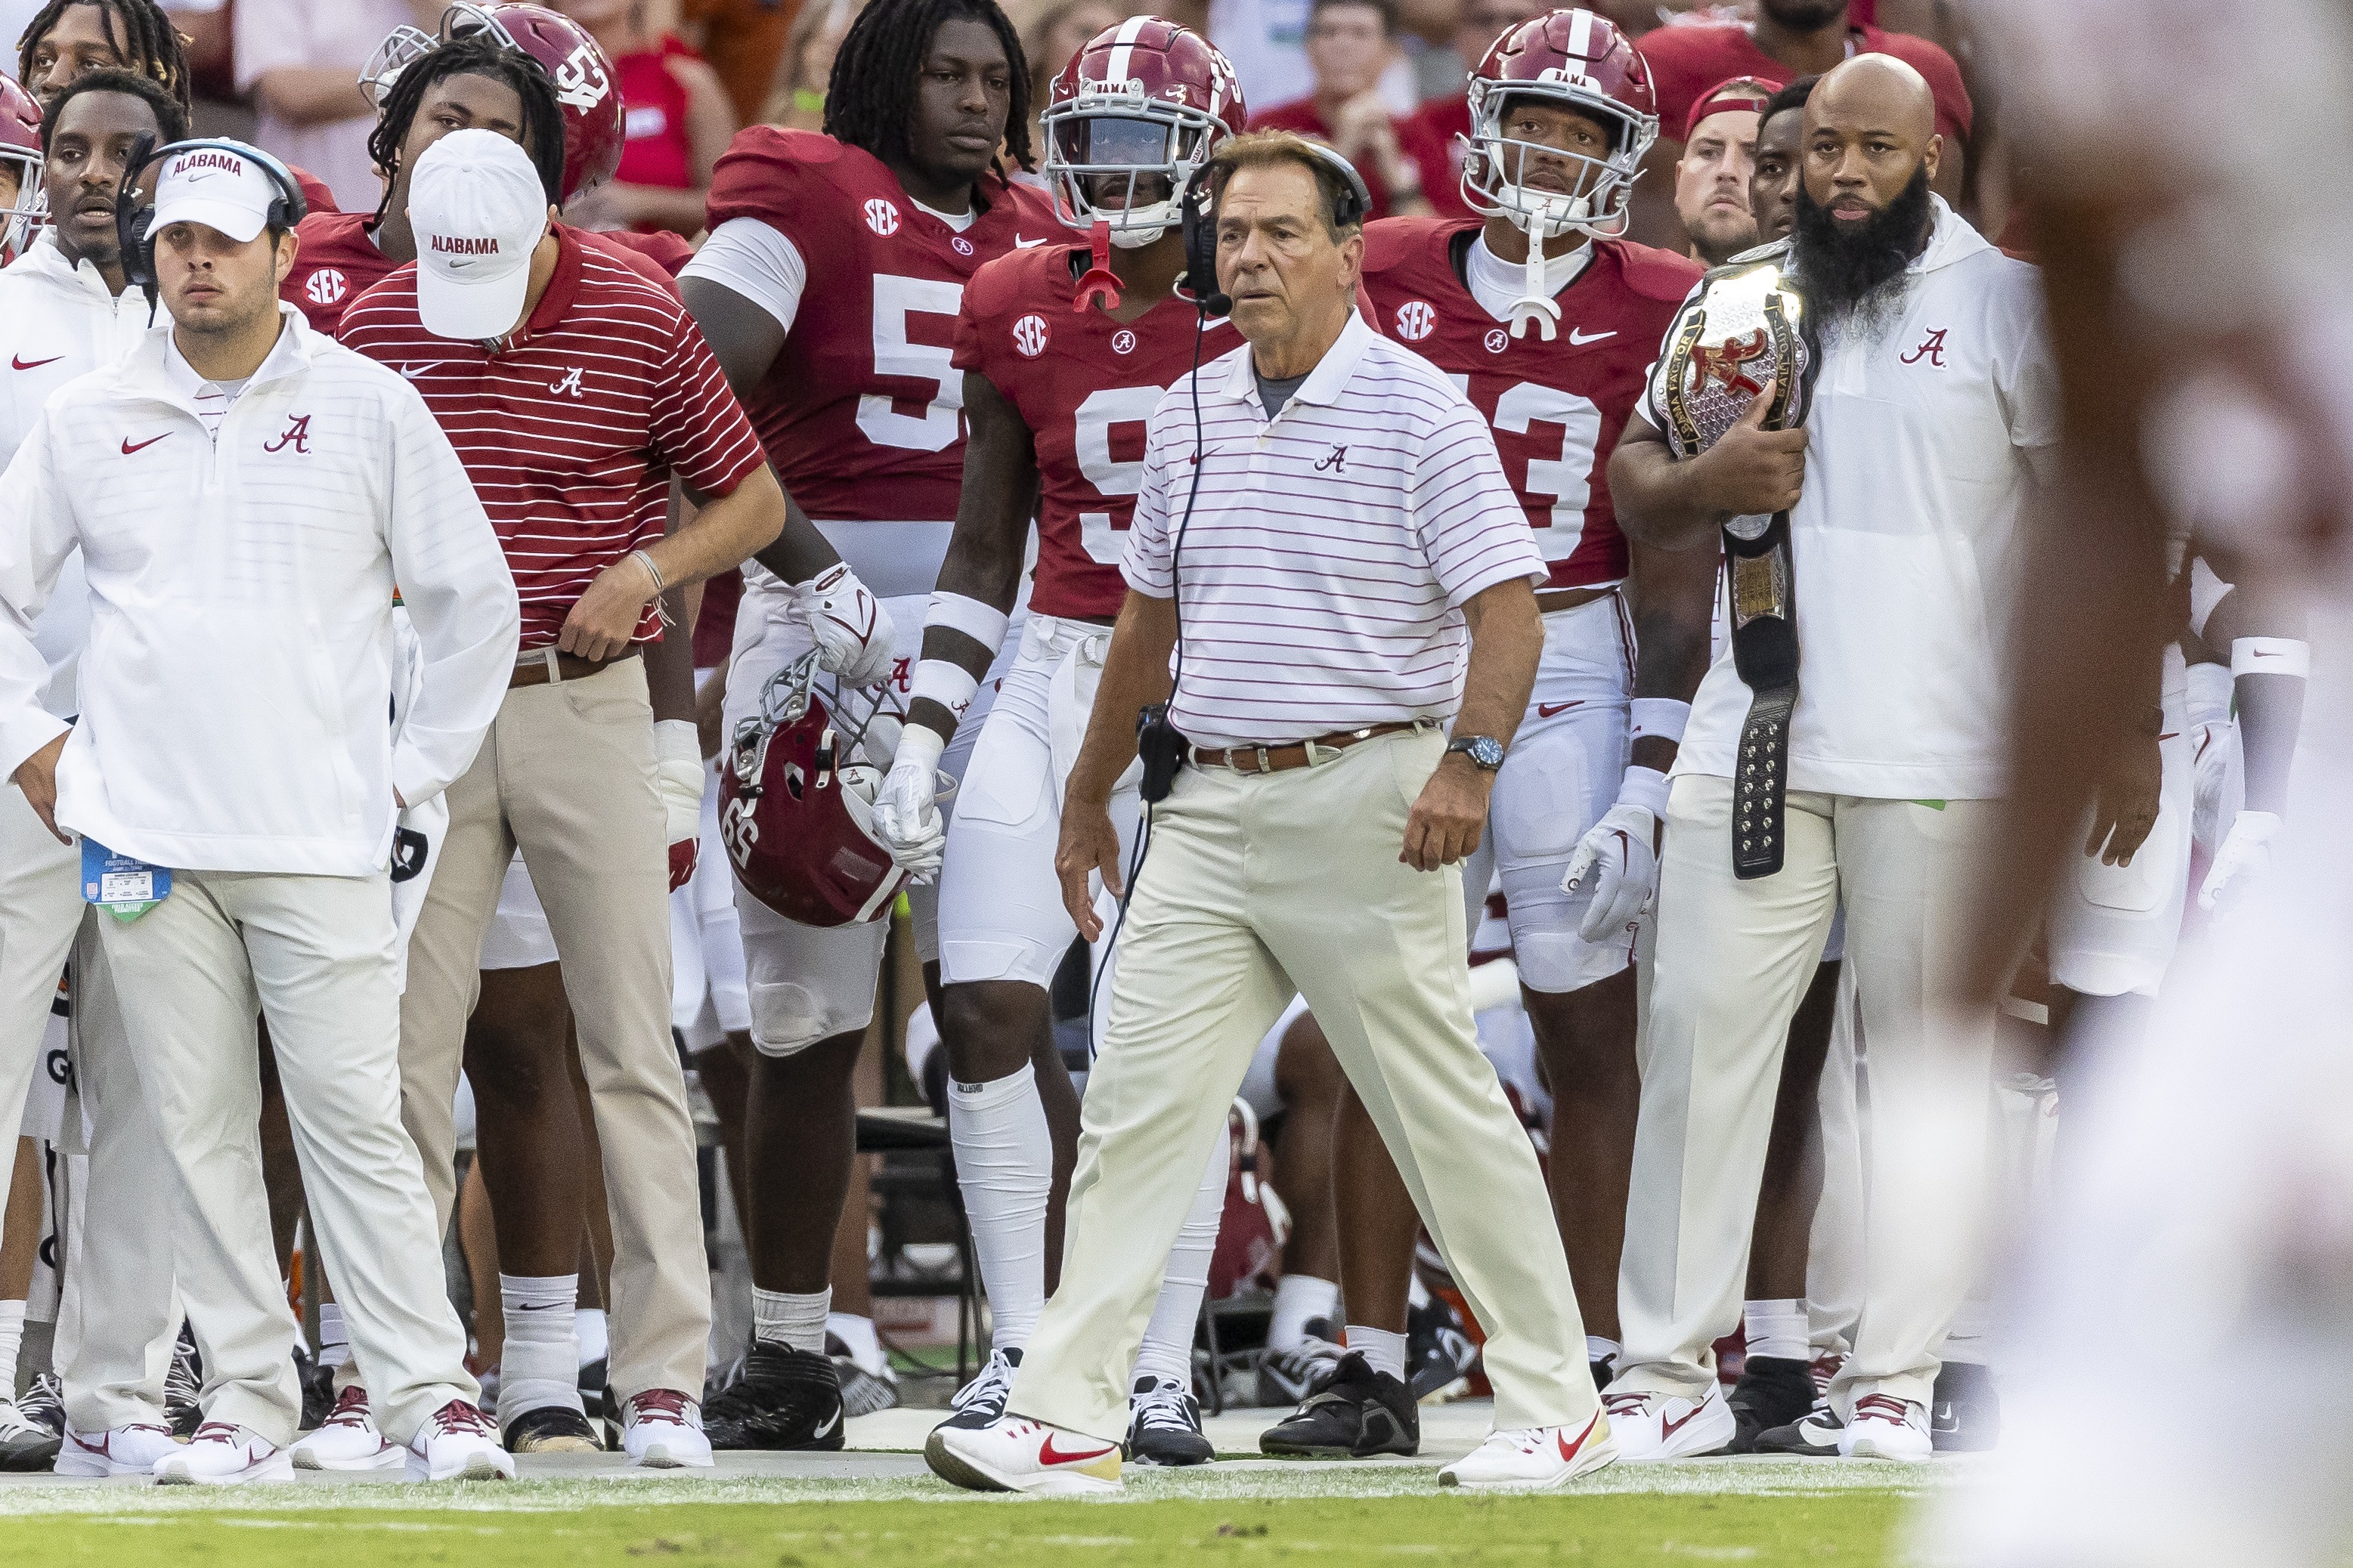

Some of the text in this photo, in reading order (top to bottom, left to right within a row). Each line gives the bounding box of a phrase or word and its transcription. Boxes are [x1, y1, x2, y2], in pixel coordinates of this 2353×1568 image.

[556, 45, 609, 116] 52
[1096, 83, 1129, 94] BAMA
[1555, 70, 1587, 88] BAMA
[172, 153, 242, 178] ALABAMA
[863, 198, 899, 237] SEC
[430, 233, 500, 255] ALABAMA
[305, 268, 347, 305] SEC
[1012, 314, 1048, 357] SEC
[1395, 301, 1436, 341] SEC
[855, 274, 971, 453] 5
[1900, 326, 1949, 369] A
[550, 366, 584, 398] A
[1668, 334, 1693, 438] BAMA FACTOR
[263, 413, 311, 454] A
[1074, 385, 1166, 565] 9
[1314, 445, 1348, 474] A
[1447, 373, 1602, 563] 3
